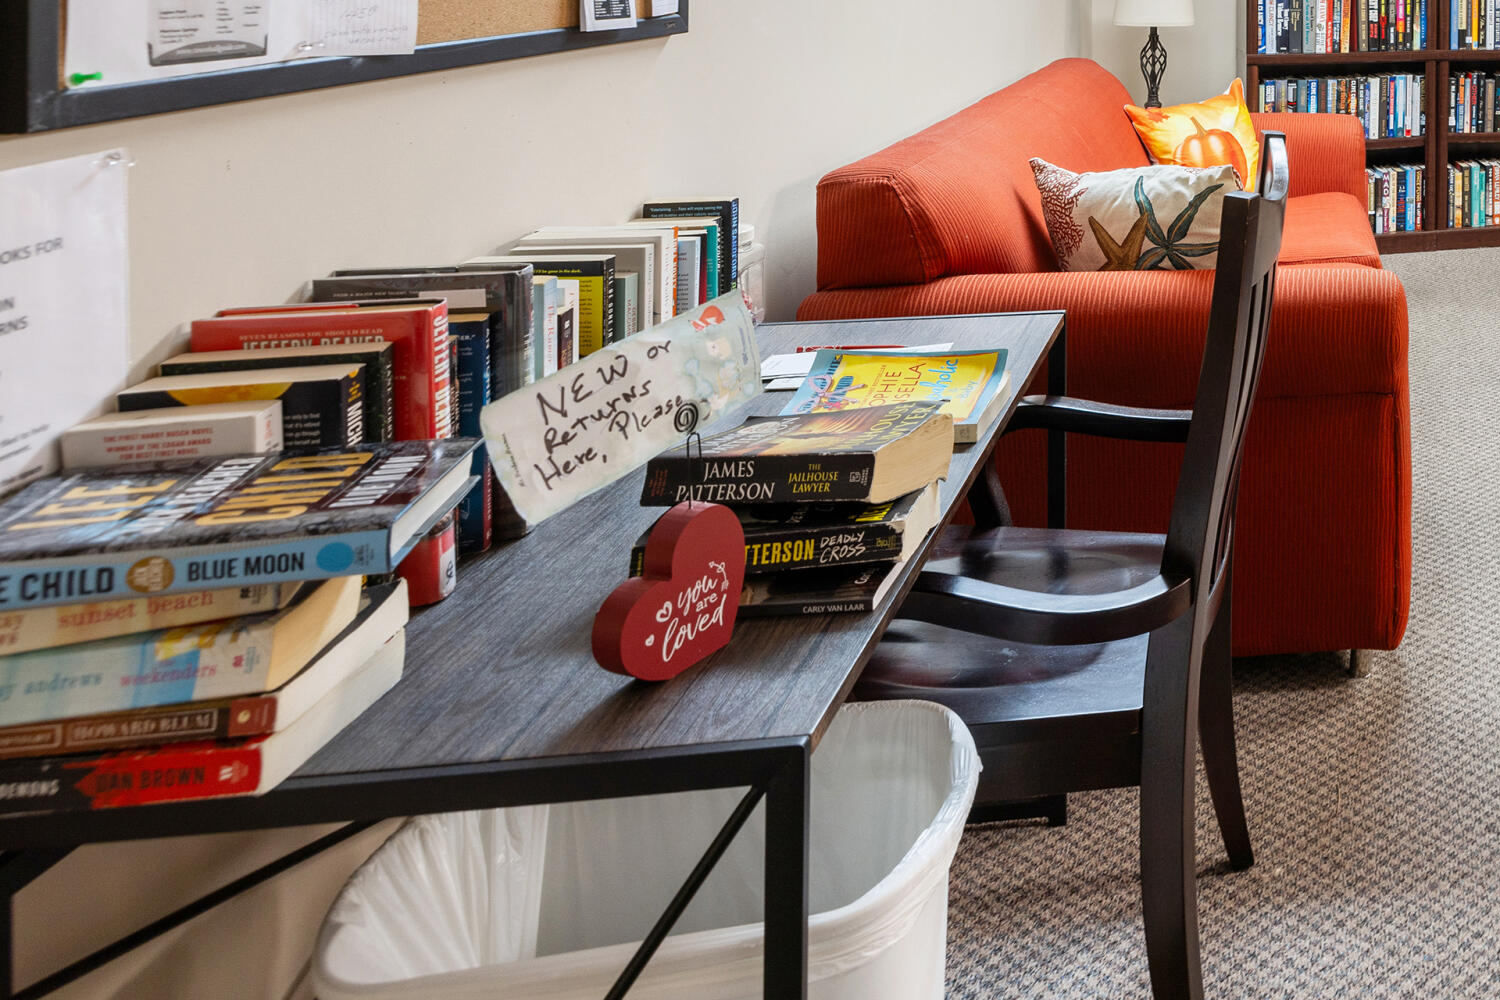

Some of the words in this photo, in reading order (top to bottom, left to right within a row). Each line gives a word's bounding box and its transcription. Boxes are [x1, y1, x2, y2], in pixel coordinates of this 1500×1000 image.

[731, 201, 739, 226] JOHN
[36, 236, 64, 257] FOR
[731, 228, 739, 279] SANDFORD
[434, 315, 449, 383] JEFFERY
[537, 353, 629, 425] NEW
[646, 340, 672, 361] or
[434, 385, 450, 439] DEAVE
[187, 437, 211, 446] AWARD
[533, 446, 608, 491] Here,
[608, 394, 684, 441] Please
[703, 460, 755, 481] JAMES
[788, 471, 839, 484] JAILHOUSE
[808, 463, 822, 471] THE
[194, 451, 374, 527] CHILD
[675, 482, 775, 502] PATTERSON
[792, 481, 831, 494] LAWYER
[744, 538, 815, 566] TTERSON
[819, 531, 865, 549] DEADLY
[819, 543, 867, 564] CROSS
[20, 567, 114, 601] CHILD
[187, 557, 237, 583] BLUE
[243, 552, 304, 577] MOON
[677, 572, 718, 609] you
[695, 592, 718, 612] are
[58, 602, 137, 630] sunset
[146, 590, 214, 615] beach
[802, 604, 826, 614] CARLY
[827, 604, 842, 613] VAN
[844, 603, 865, 612] LAAR
[662, 593, 727, 662] loved
[24, 671, 104, 697] andrews
[119, 663, 218, 688] weekenders
[95, 771, 134, 792] DAN
[138, 766, 206, 790] BROWN
